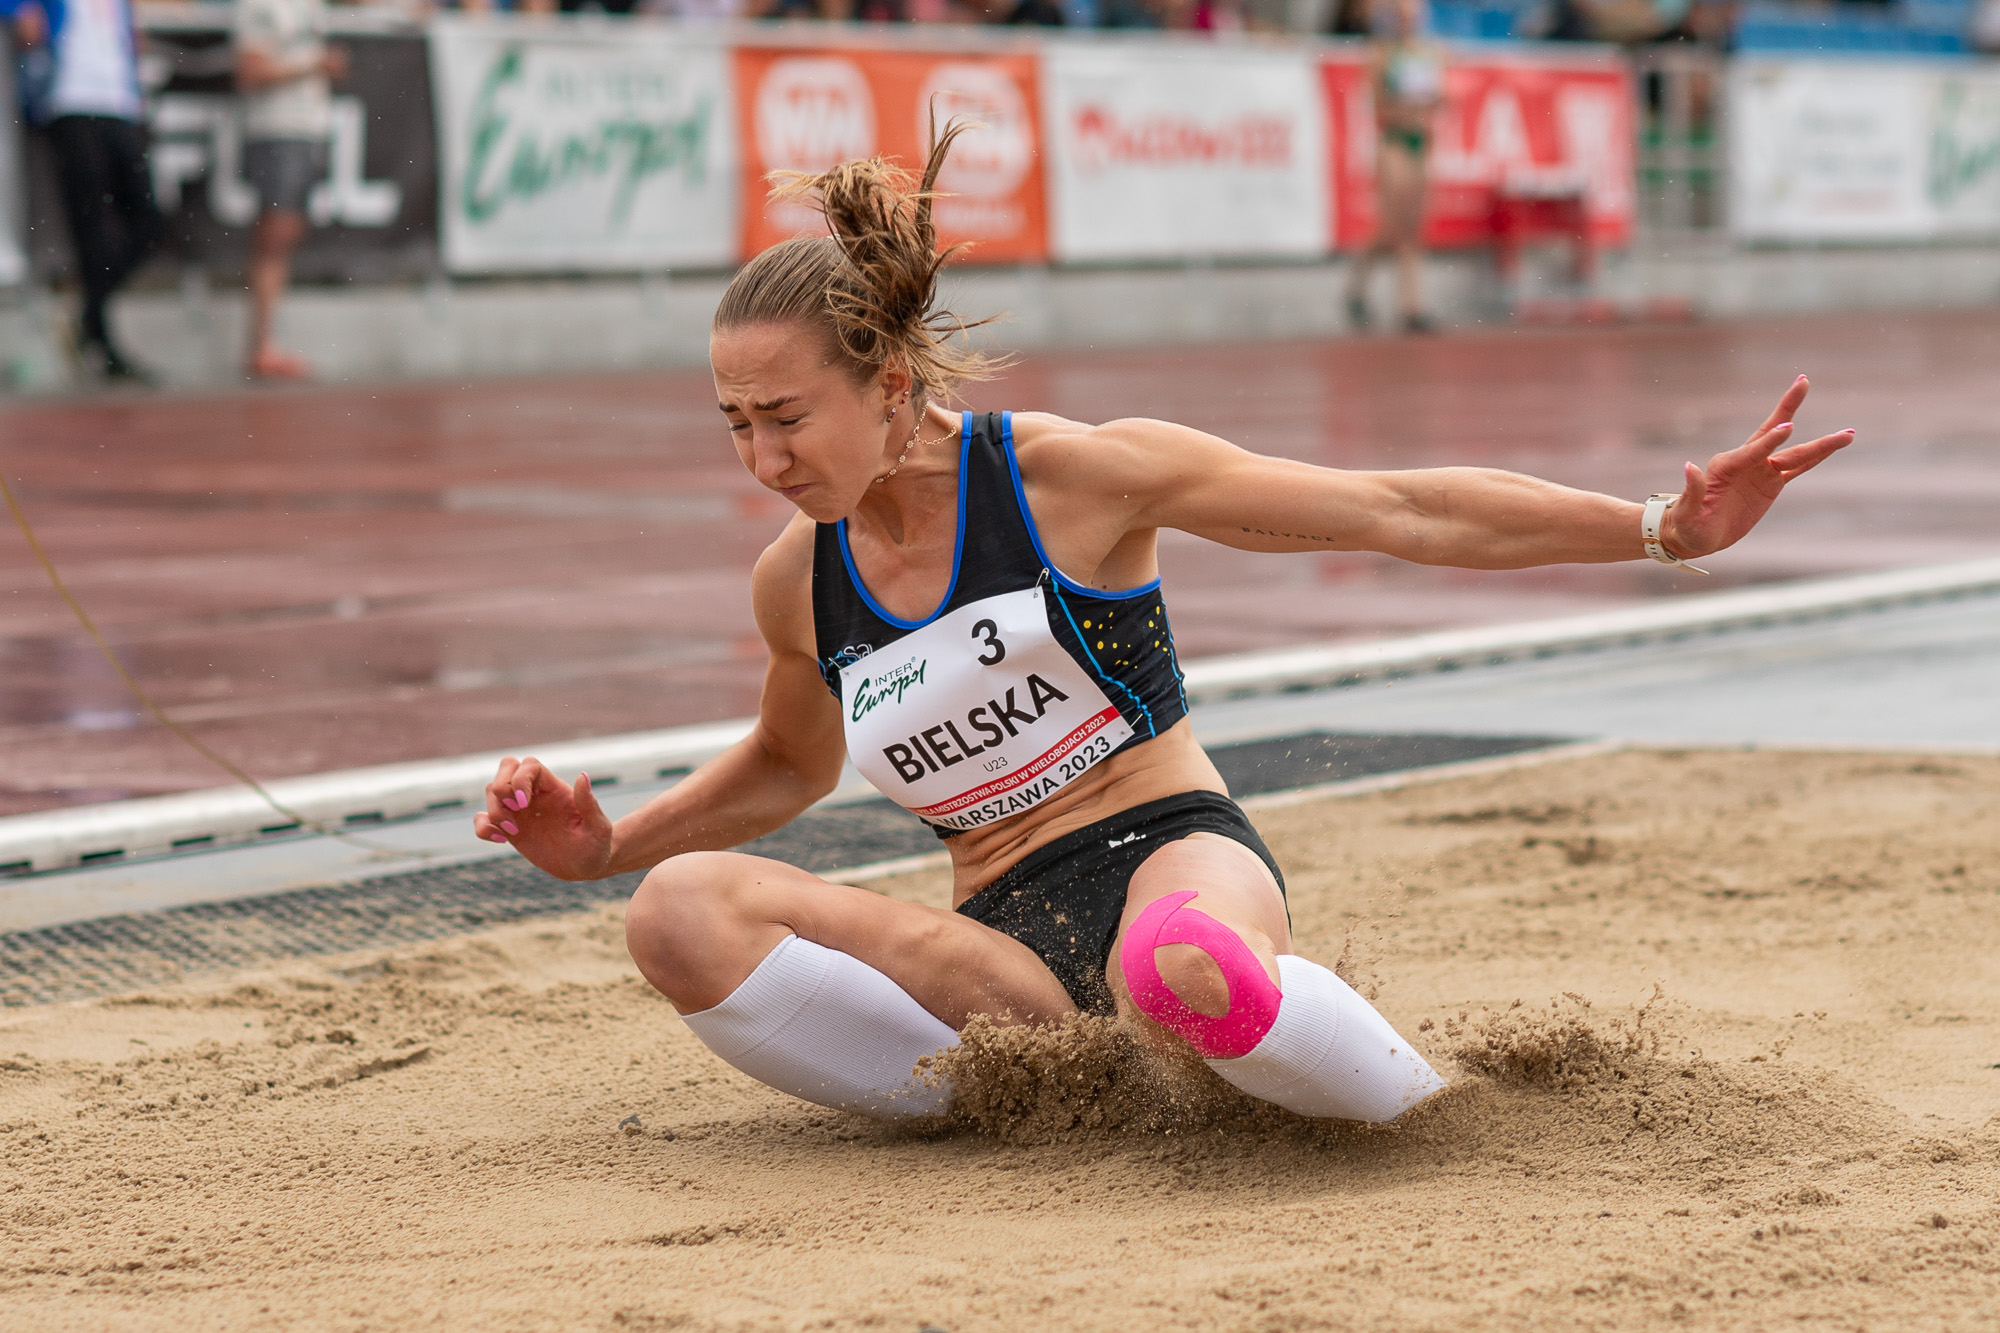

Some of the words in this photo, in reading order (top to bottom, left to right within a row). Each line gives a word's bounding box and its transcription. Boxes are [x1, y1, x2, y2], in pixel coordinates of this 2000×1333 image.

[875, 662, 913, 687] INTER
[971, 618, 1006, 667] 3
[852, 659, 927, 723] Europol
[882, 673, 1070, 785] BIELSKA
[934, 787, 992, 815] MISTRZOSTWA
[989, 776, 1020, 793] POLSKI
[1018, 770, 1029, 781] W
[1027, 729, 1087, 775] WIELOBOJACH
[1085, 715, 1106, 734] 2023
[937, 777, 1060, 828] WARSZAWA
[1059, 736, 1110, 782] 2023
[983, 756, 1009, 774] U23
